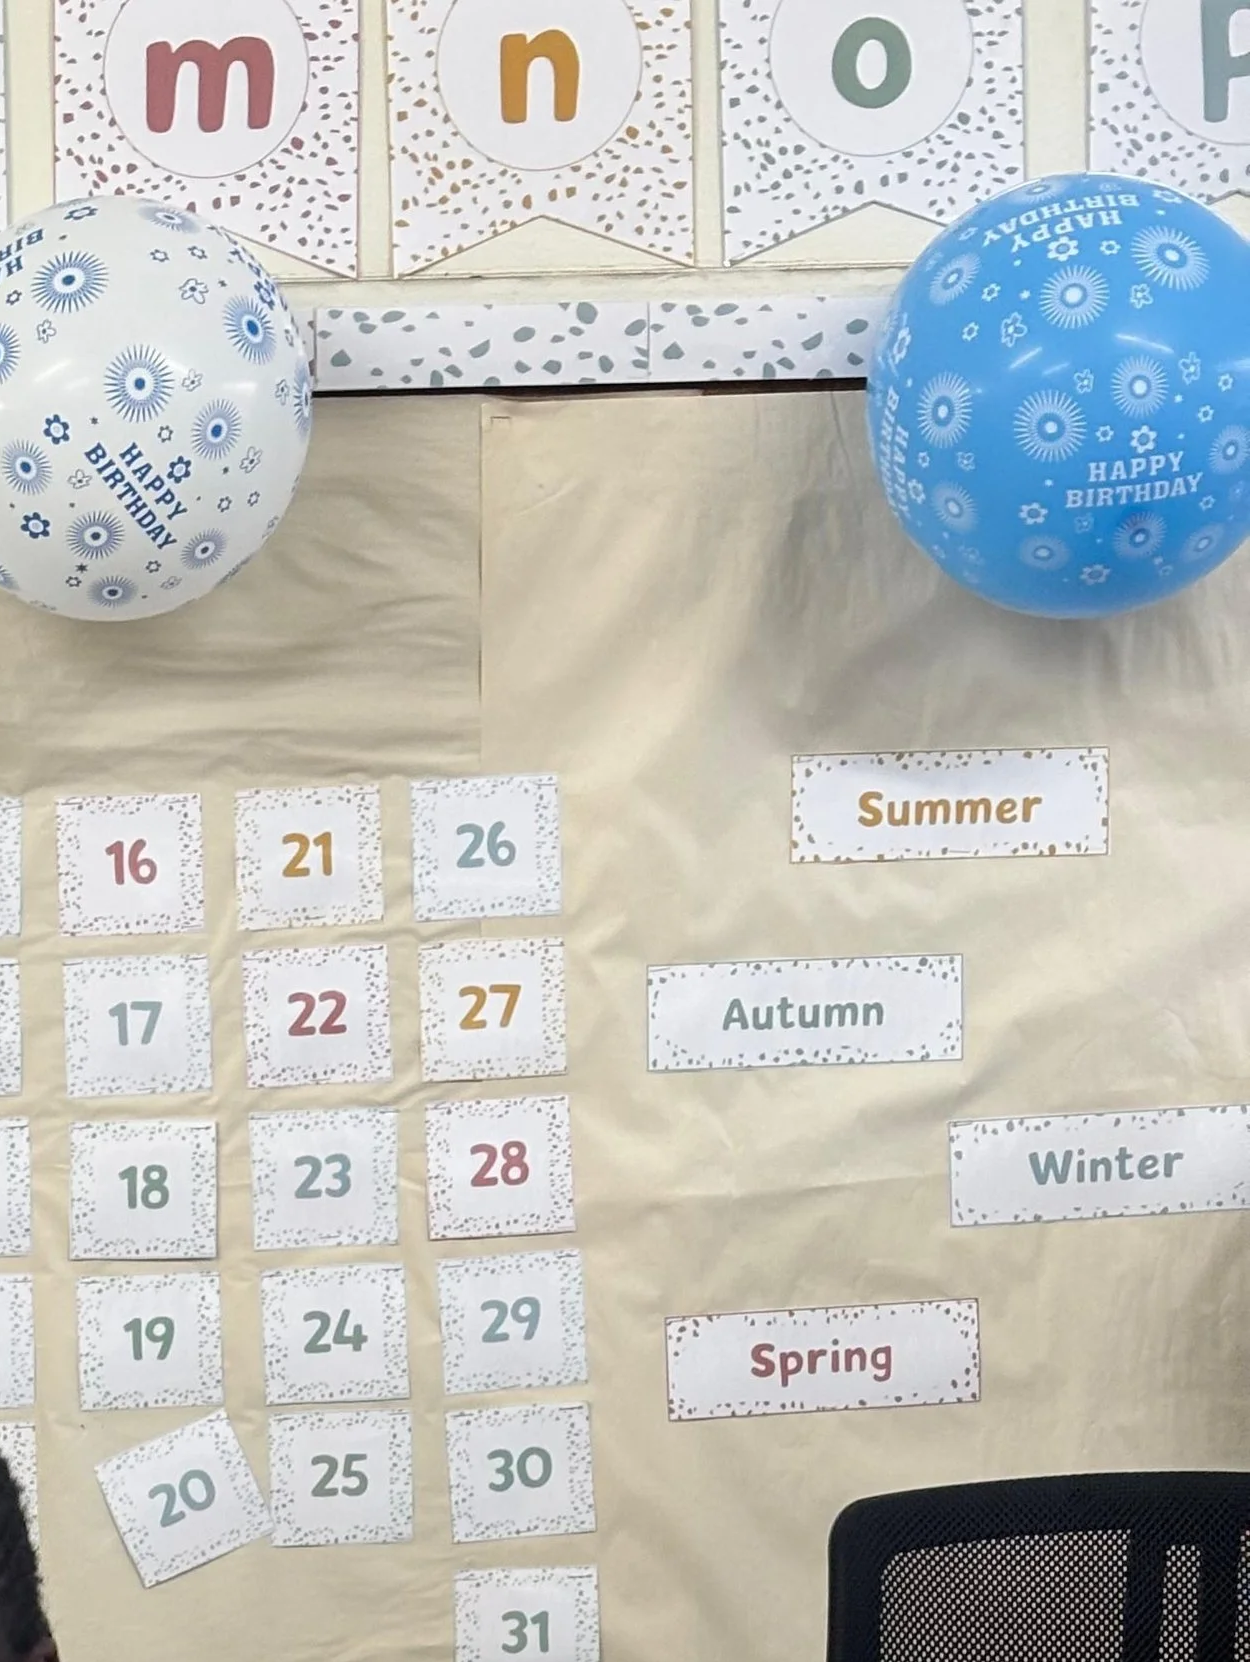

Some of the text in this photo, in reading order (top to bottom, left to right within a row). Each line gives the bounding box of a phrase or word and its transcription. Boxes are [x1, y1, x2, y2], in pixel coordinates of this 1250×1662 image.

[146, 36, 275, 133] m
[500, 28, 580, 124] n
[832, 17, 911, 109] o
[982, 194, 1141, 247] BIRTHDAY
[1011, 210, 1122, 253] HAPPY
[119, 442, 187, 520] HAPPY
[1088, 451, 1184, 482] HAPPY
[84, 442, 177, 550] BIRTHDAY
[1065, 472, 1203, 508] BIRTHDAY
[858, 791, 1042, 827] Summer
[105, 839, 157, 885] 16
[282, 832, 332, 878] 21
[457, 821, 516, 868] 26
[109, 1002, 162, 1046] 17
[288, 991, 347, 1036] 22
[459, 984, 521, 1030] 27
[723, 997, 883, 1031] Autumn
[295, 1154, 351, 1199] 23
[470, 1141, 529, 1187] 28
[1029, 1147, 1183, 1185] Winter
[119, 1165, 169, 1209] 18
[123, 1317, 174, 1361] 19
[303, 1309, 368, 1353] 24
[481, 1297, 540, 1343] 29
[751, 1339, 891, 1388] Spring
[311, 1454, 368, 1497] 25
[487, 1447, 552, 1492] 30
[149, 1470, 215, 1527] 20
[502, 1611, 549, 1654] 31
